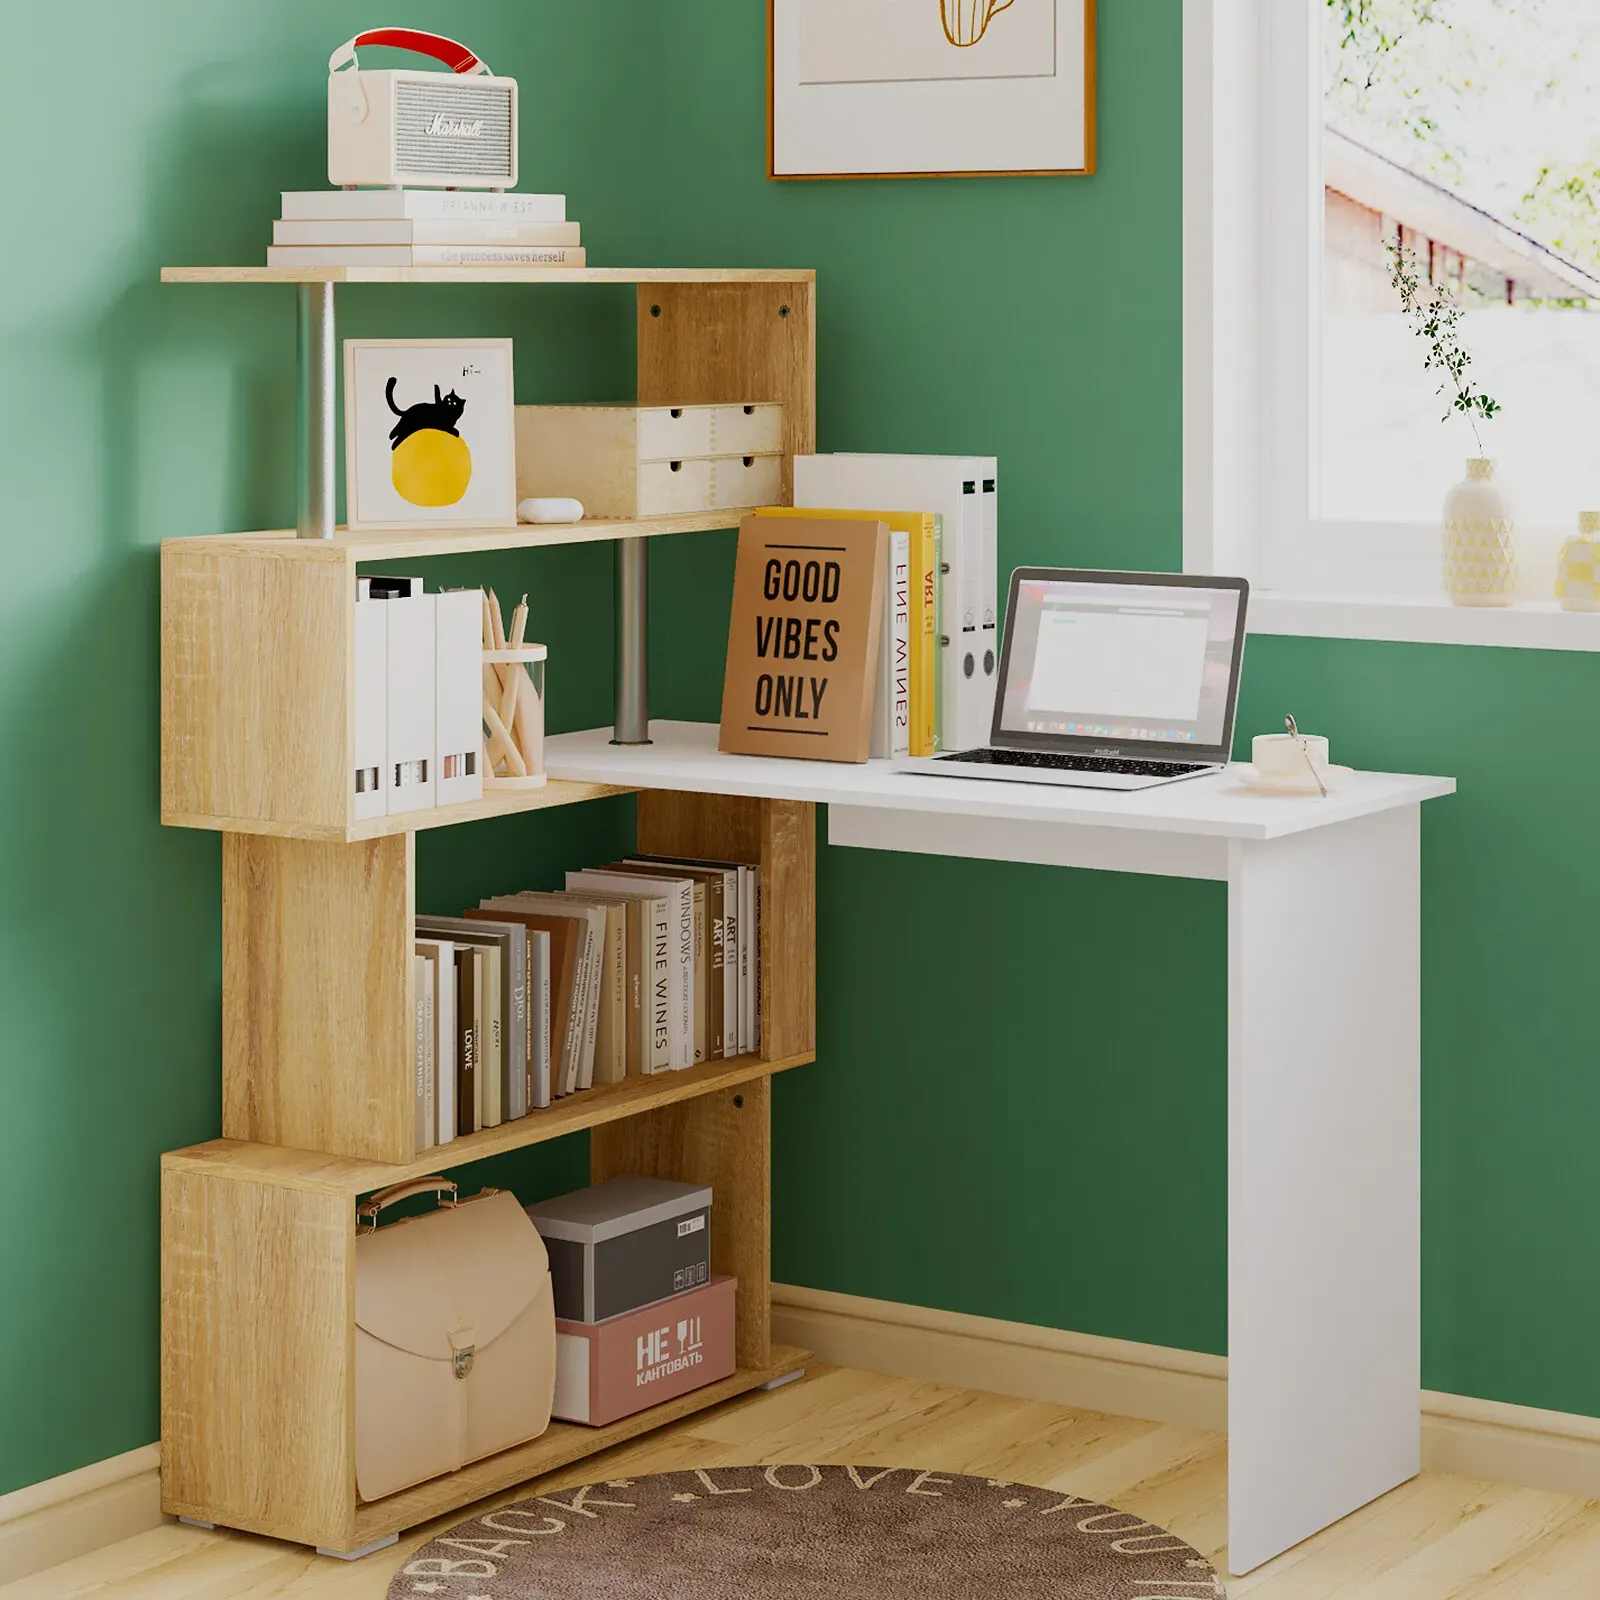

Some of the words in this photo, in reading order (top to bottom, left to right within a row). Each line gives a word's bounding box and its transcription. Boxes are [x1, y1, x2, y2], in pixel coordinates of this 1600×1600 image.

[423, 112, 483, 136] Marshall
[460, 252, 503, 265] princess
[504, 253, 531, 263] saves
[531, 250, 566, 263] herself
[763, 558, 842, 604] GOOD
[756, 615, 840, 662] VIBES
[754, 673, 829, 720] ONLY
[655, 922, 668, 970] FINE
[680, 886, 692, 964] WINDOWS
[713, 918, 723, 947] ART
[726, 916, 736, 943] ART
[416, 1000, 424, 1041] GRAND
[655, 978, 668, 1050] WINES
[416, 1044, 424, 1097] OPENING
[464, 1029, 473, 1070] LOEWE
[636, 1326, 670, 1371] НЕ
[636, 1351, 703, 1387] КАНТОВАТЬ
[692, 1463, 956, 1497] LOVE
[402, 1484, 638, 1579] BACK
